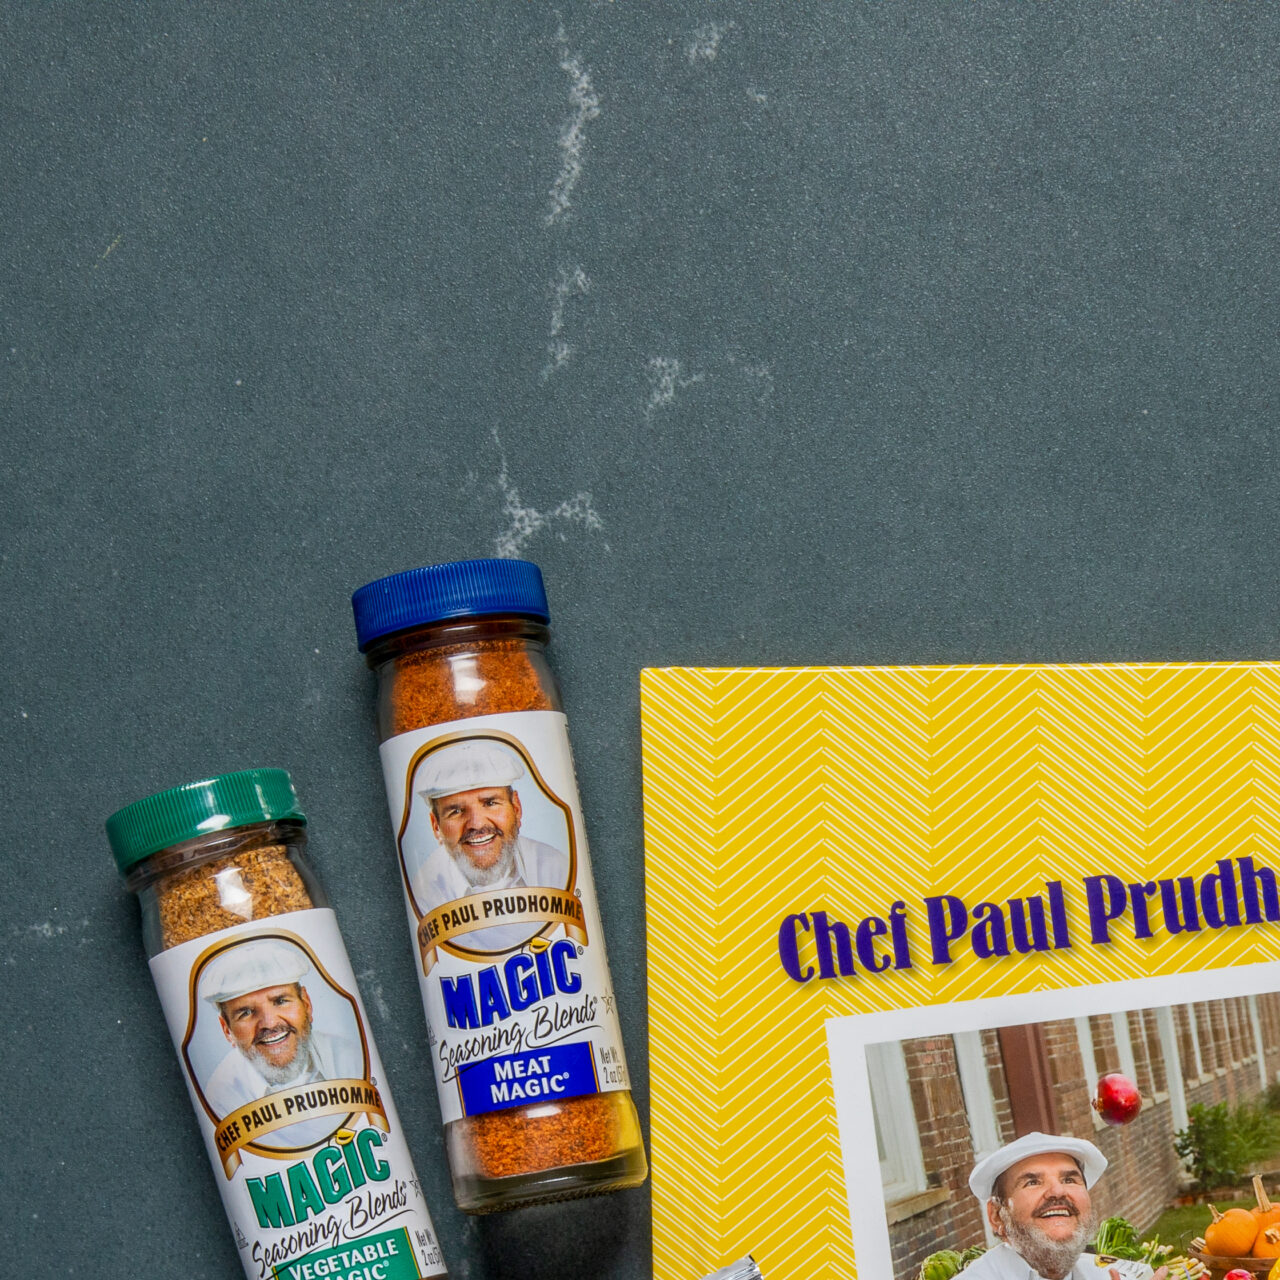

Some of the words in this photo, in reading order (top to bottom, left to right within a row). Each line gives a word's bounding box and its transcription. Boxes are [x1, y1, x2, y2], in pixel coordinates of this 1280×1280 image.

[418, 918, 439, 948] CHEF
[441, 903, 479, 931] PAUL
[482, 895, 582, 921] PRUDHOMME
[778, 900, 914, 983] Chef
[924, 881, 1073, 965] Paul
[439, 1022, 527, 1080] Seasoning
[493, 1056, 551, 1082] MEAT
[217, 1121, 242, 1151] CHEF
[241, 1102, 282, 1132] PAUL
[283, 1086, 381, 1116] PRUDHOMME
[252, 1215, 342, 1280] Seasoning
